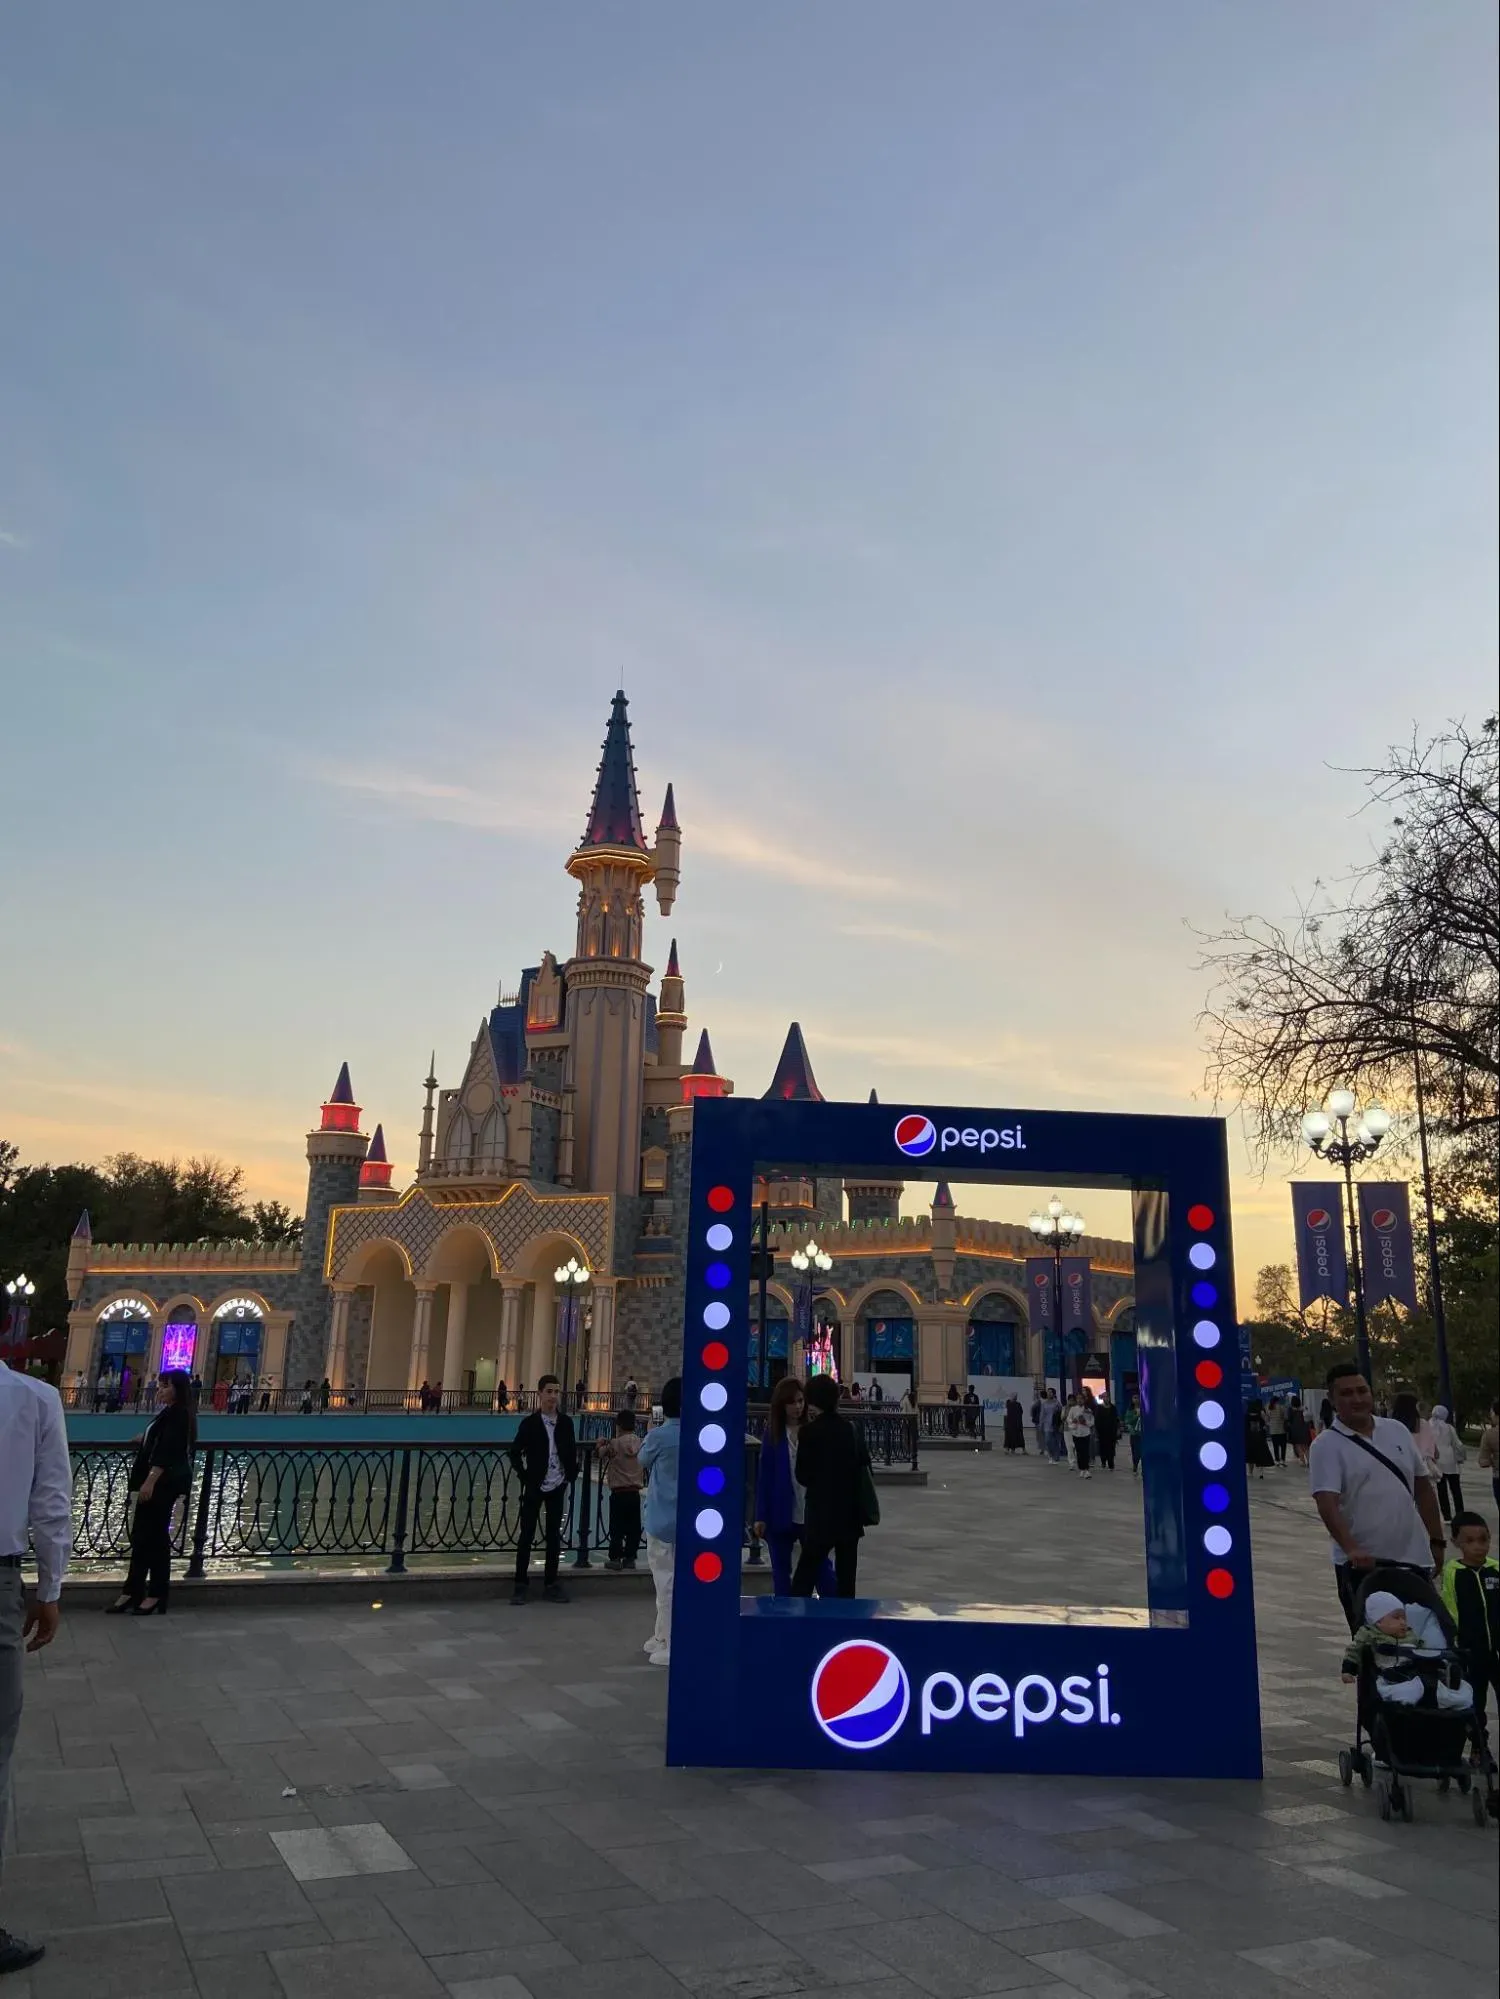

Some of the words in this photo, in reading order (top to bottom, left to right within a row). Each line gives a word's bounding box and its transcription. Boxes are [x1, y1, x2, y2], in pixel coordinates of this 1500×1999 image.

[941, 1124, 1027, 1153] pepsi.
[1312, 1235, 1333, 1277] pepsi
[1377, 1235, 1397, 1278] pepsi
[921, 1663, 1121, 1738] pepsi.
